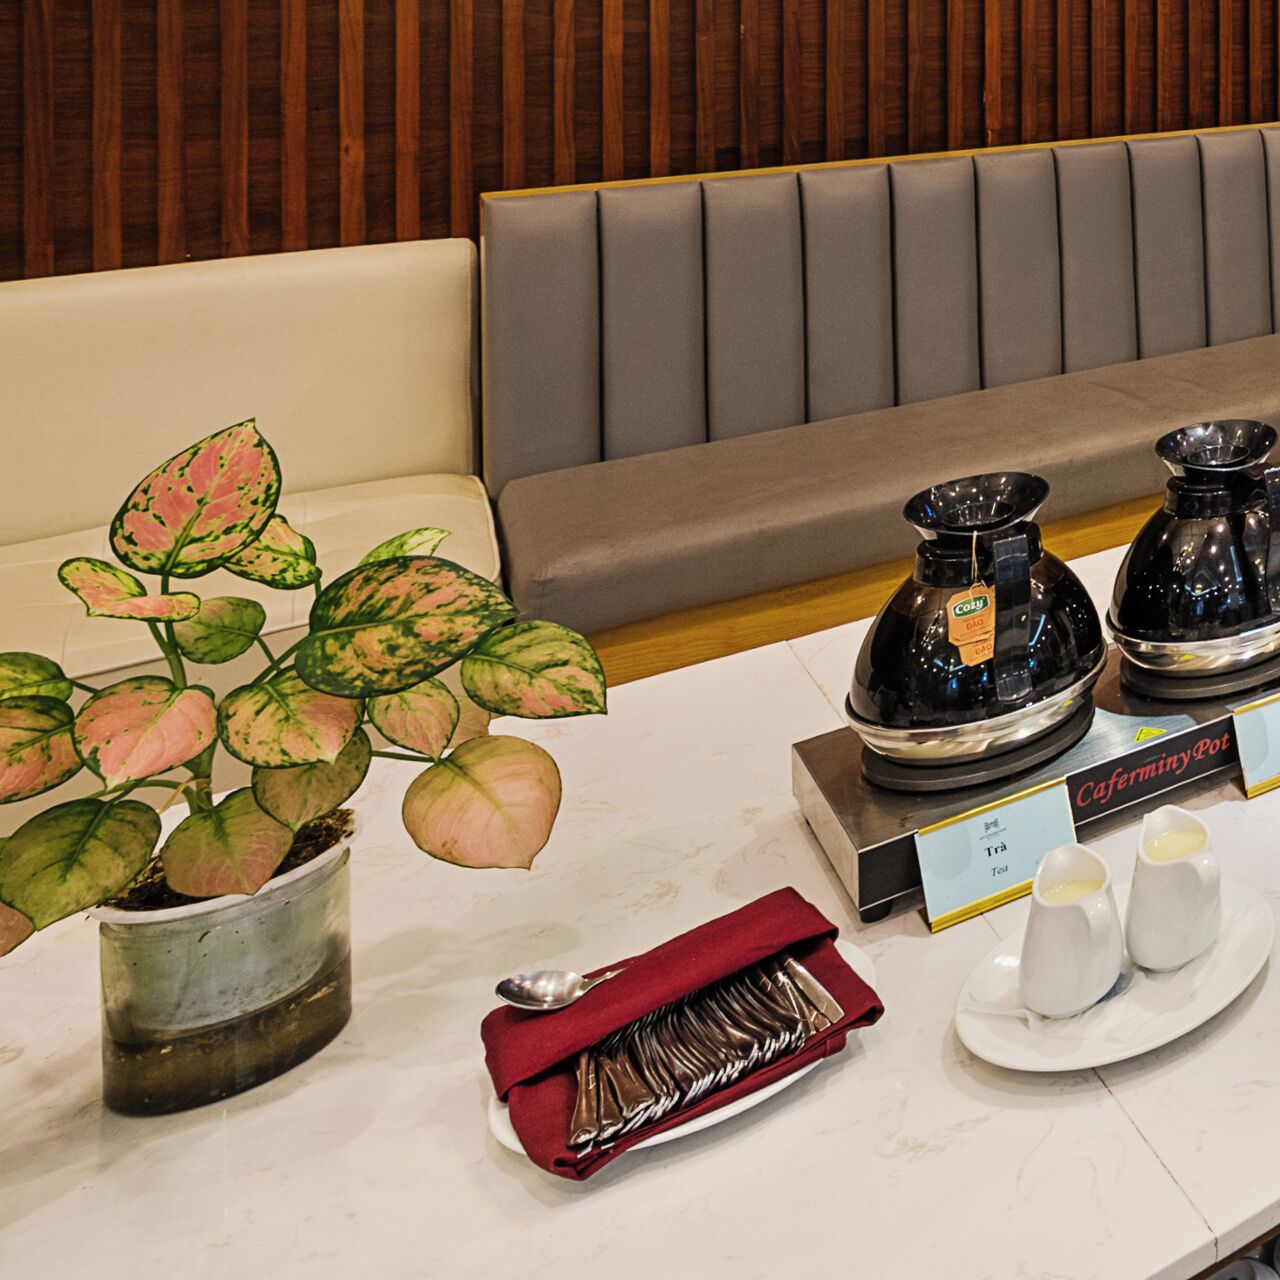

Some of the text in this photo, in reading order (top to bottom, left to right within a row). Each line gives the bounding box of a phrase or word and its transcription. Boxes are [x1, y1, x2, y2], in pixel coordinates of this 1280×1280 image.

[955, 599, 984, 615] Cozy
[984, 841, 1007, 857] Trà
[991, 865, 1009, 877] Tea
